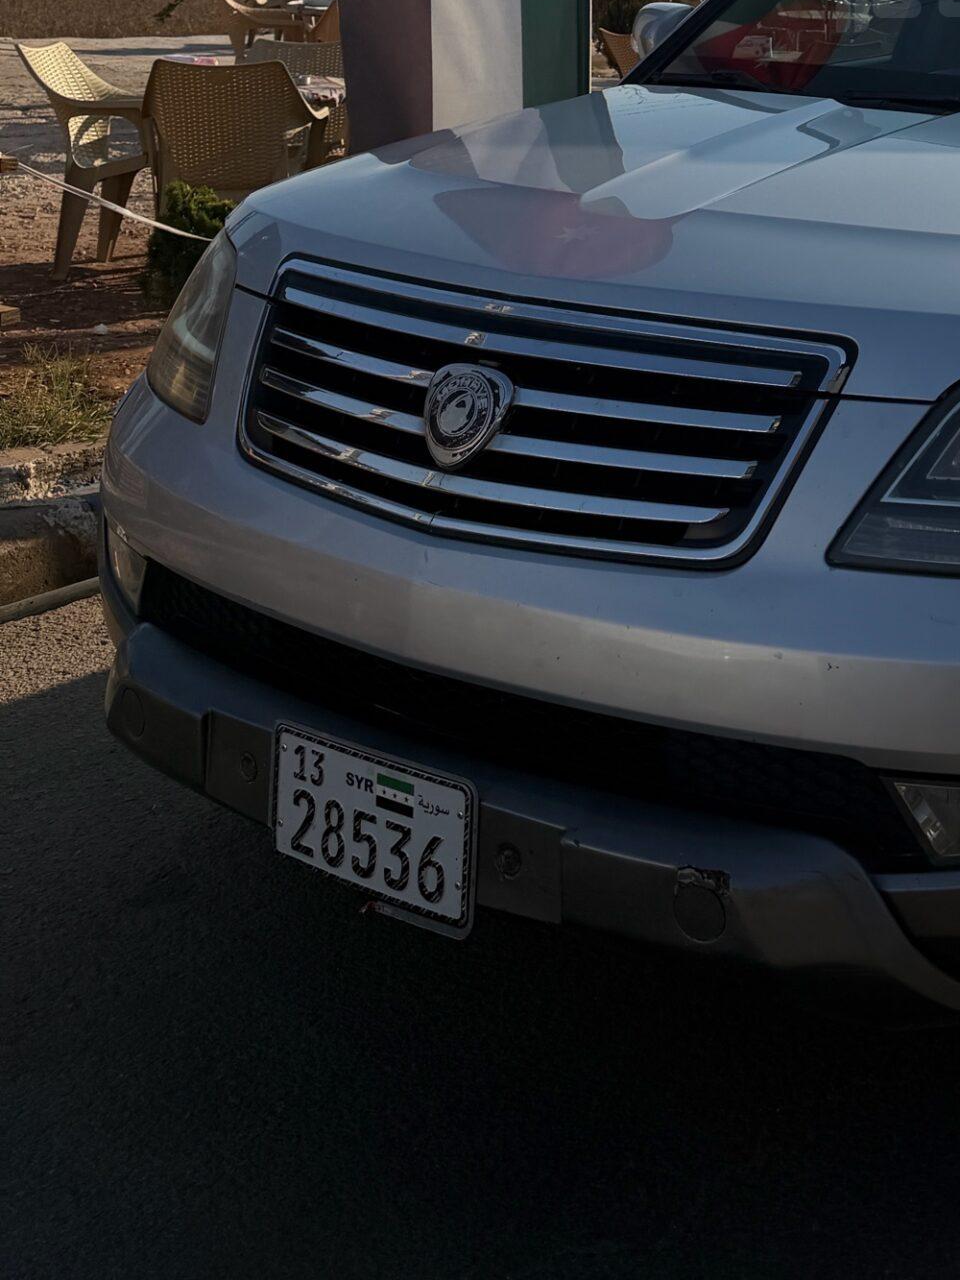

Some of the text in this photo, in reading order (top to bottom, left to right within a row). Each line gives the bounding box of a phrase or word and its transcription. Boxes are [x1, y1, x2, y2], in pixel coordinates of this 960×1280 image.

[293, 745, 326, 786] 13
[345, 773, 374, 794] SYR
[418, 794, 450, 816] سورية
[290, 789, 446, 904] 28536
